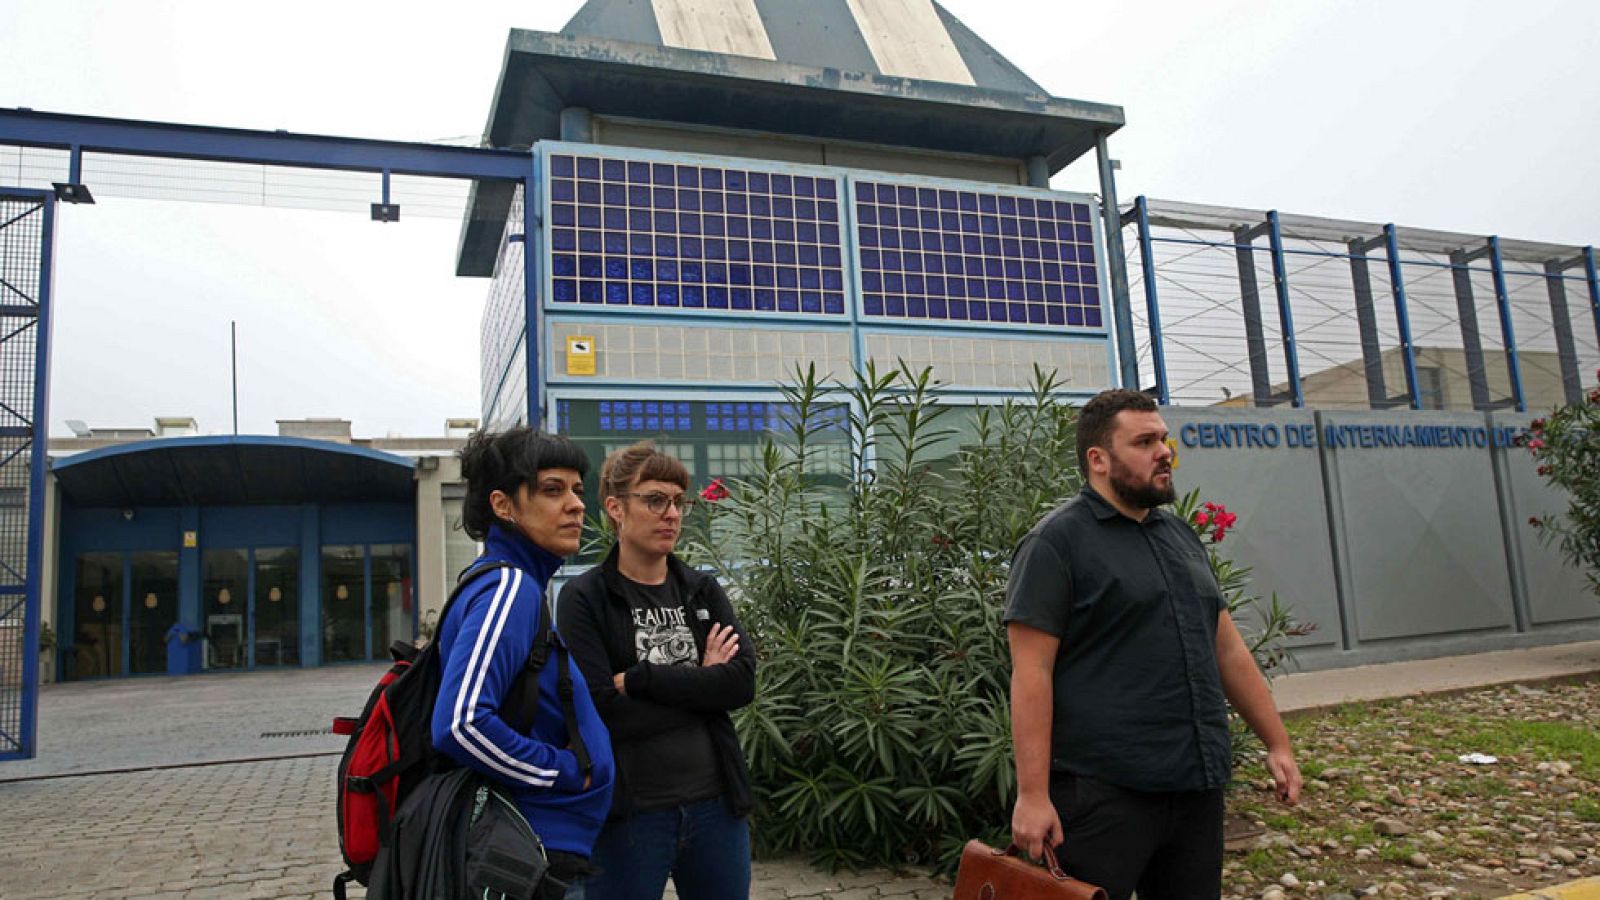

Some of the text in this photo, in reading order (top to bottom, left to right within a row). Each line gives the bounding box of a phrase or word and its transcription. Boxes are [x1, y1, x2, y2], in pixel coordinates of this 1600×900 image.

[1180, 423, 1281, 448] CENTRO
[1285, 424, 1315, 448] DE
[1324, 425, 1487, 449] INTERNAMIENTO
